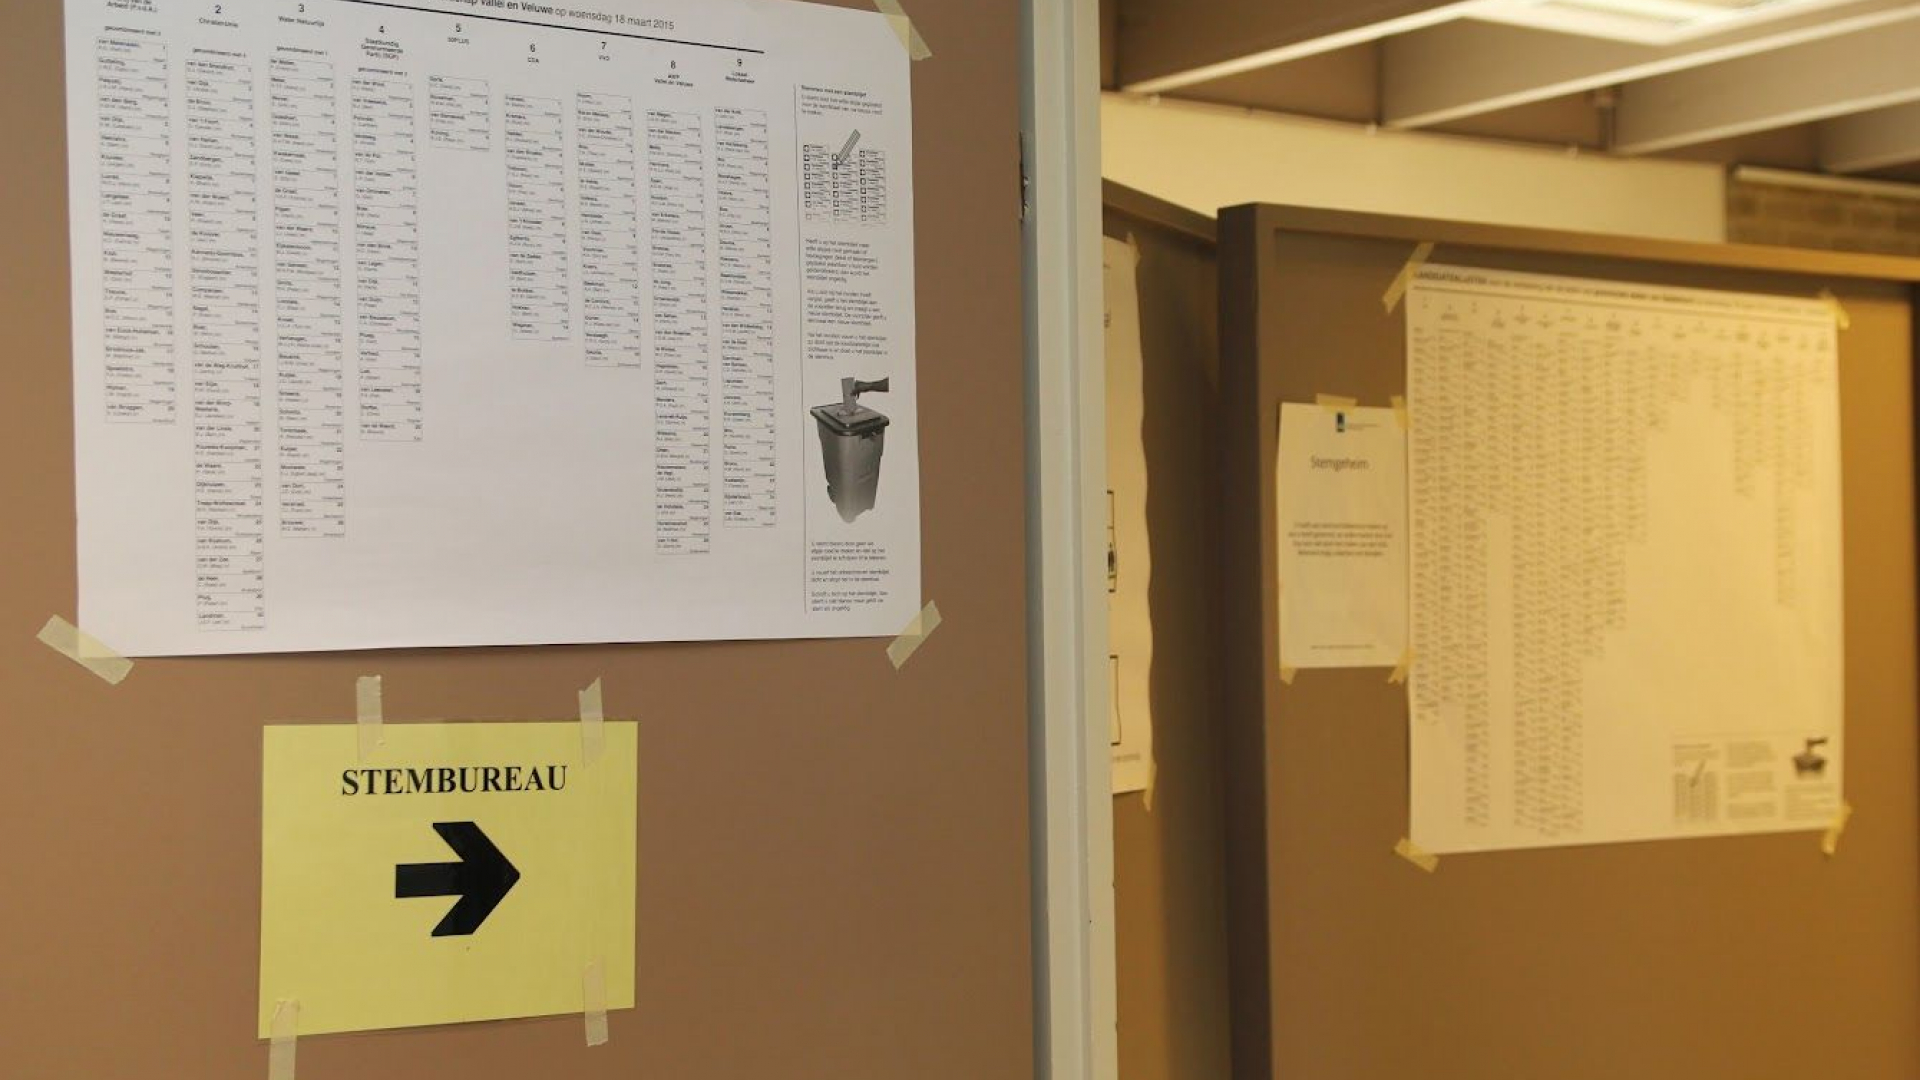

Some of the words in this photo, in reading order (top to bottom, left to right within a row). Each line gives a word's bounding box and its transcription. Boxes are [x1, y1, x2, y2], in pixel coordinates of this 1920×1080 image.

[214, 4, 222, 14] 2
[298, 3, 305, 13] 3
[507, 1, 519, 10] en
[521, 2, 554, 16] Veluwe
[554, 8, 567, 18] op
[568, 9, 613, 24] woensdag
[615, 14, 626, 24] 18
[628, 16, 653, 28] maart
[653, 18, 676, 31] 2015
[378, 25, 385, 34] 4
[455, 22, 462, 33] 5
[529, 42, 536, 53] 6
[601, 41, 607, 50] 7
[670, 60, 677, 70] 8
[736, 58, 743, 68] 9
[1309, 454, 1370, 473] Stemgeheim
[341, 765, 568, 796] STEMBUREAU
